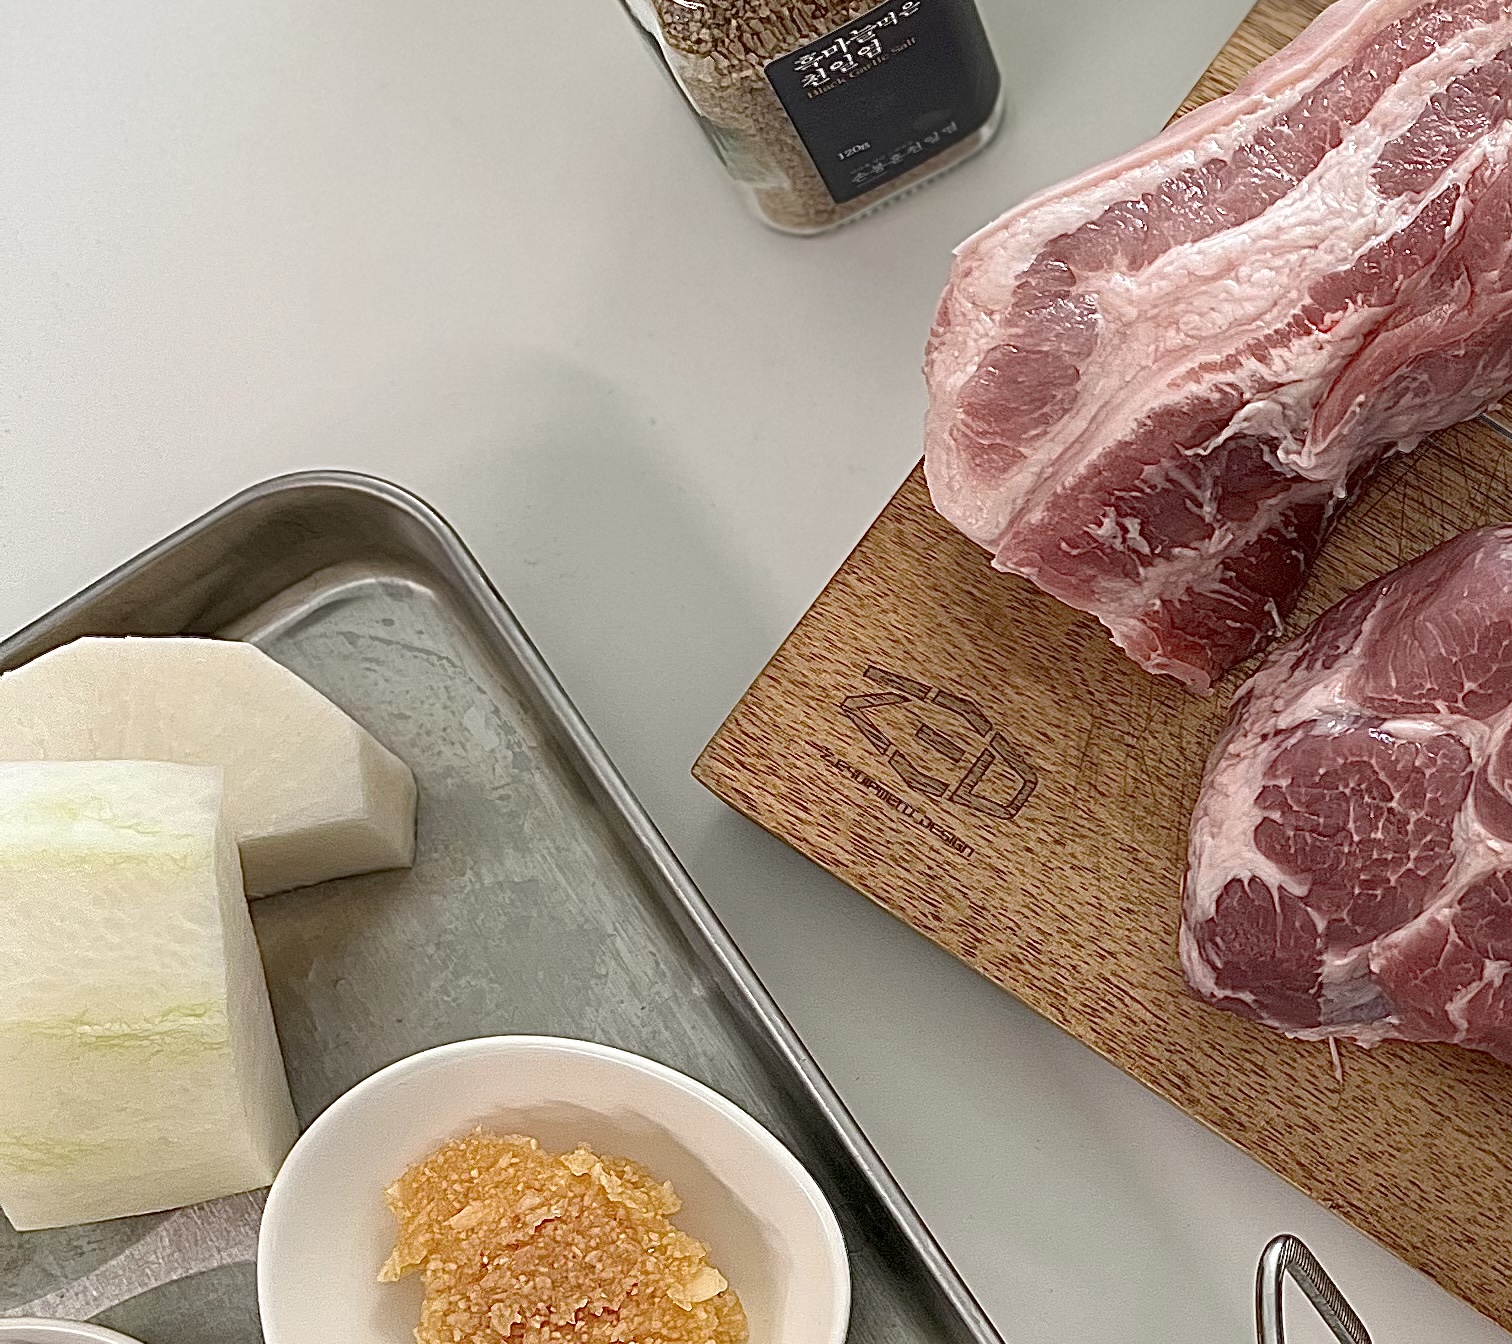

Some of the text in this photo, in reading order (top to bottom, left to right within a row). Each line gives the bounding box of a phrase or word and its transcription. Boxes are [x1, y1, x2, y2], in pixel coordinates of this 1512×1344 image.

[793, 1, 921, 71] 흑마늘먹은
[801, 38, 882, 88] 천일염
[807, 37, 916, 99] Black Garlic Salt
[836, 141, 871, 161] 120g
